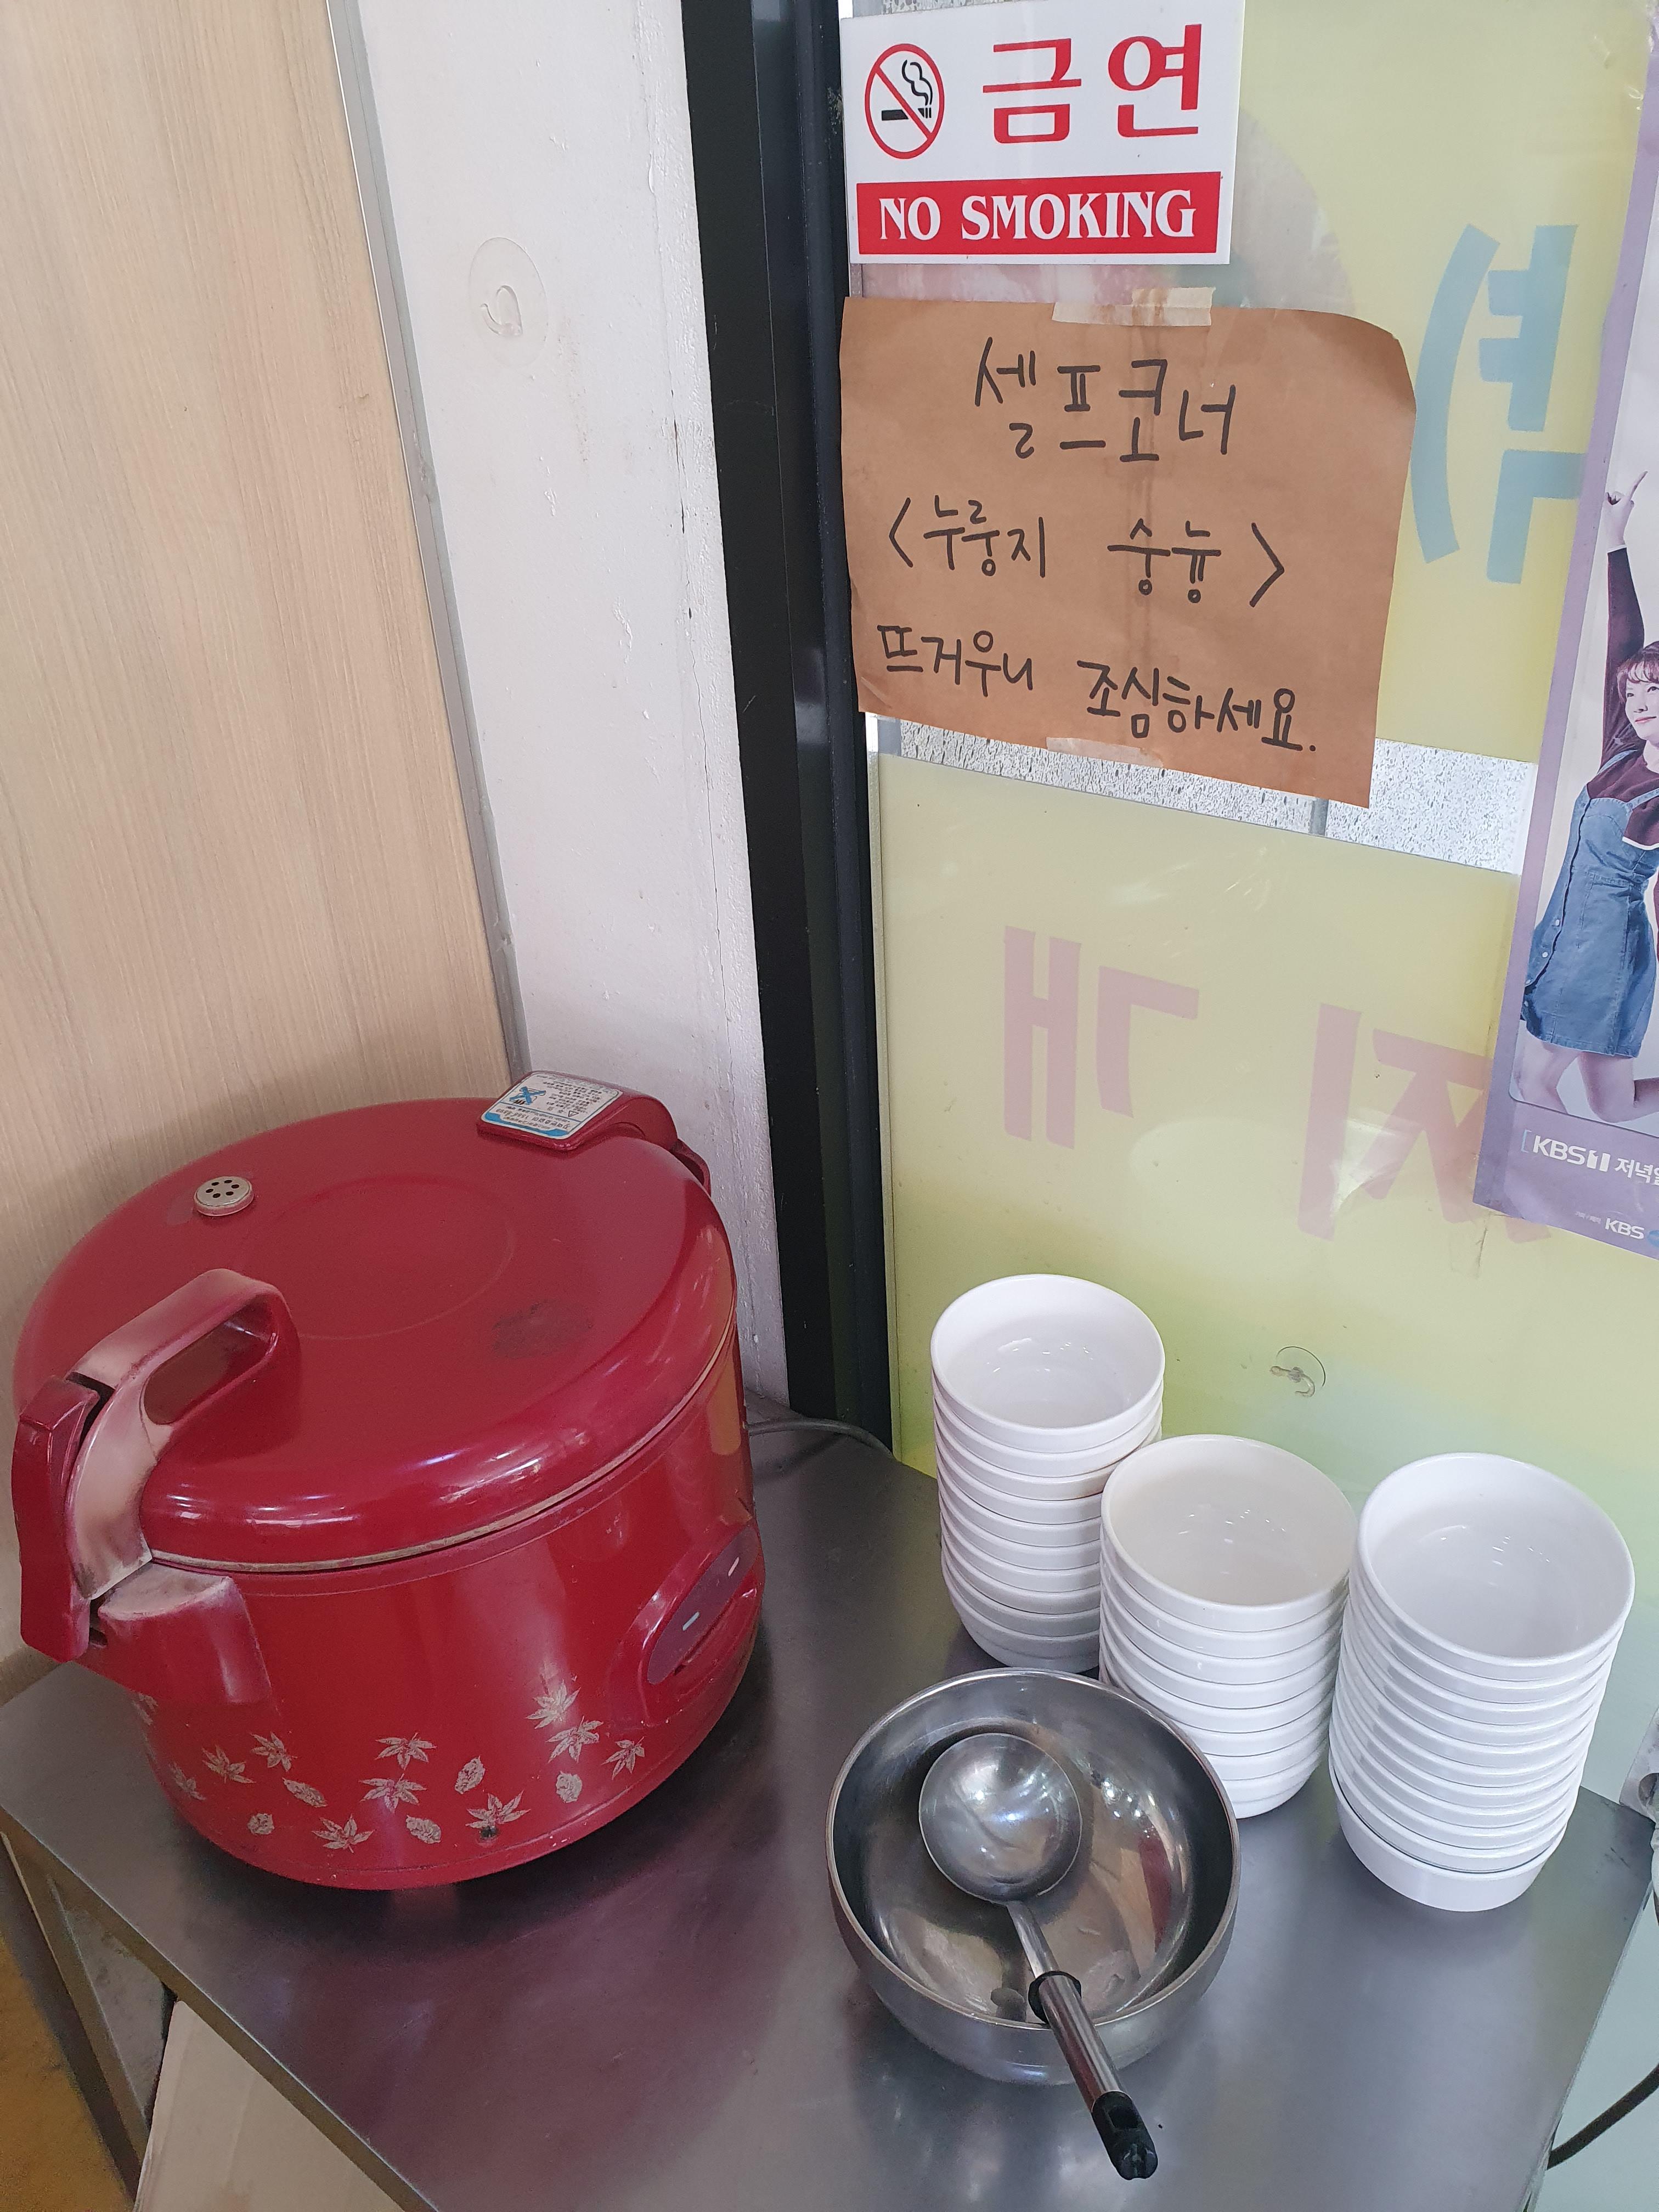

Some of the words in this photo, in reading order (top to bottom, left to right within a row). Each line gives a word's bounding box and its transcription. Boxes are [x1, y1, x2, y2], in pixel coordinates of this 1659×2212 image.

[983, 24, 1201, 144] 금연
[879, 196, 940, 240] NO
[961, 189, 1196, 240] SMOKING
[975, 337, 1235, 462] 셀프코너
[877, 625, 1032, 697] 뜨거우니
[1077, 661, 1316, 751] 조심하세요.
[1615, 1158, 1659, 1186] 저녁
[1605, 1217, 1645, 1240] KBS
